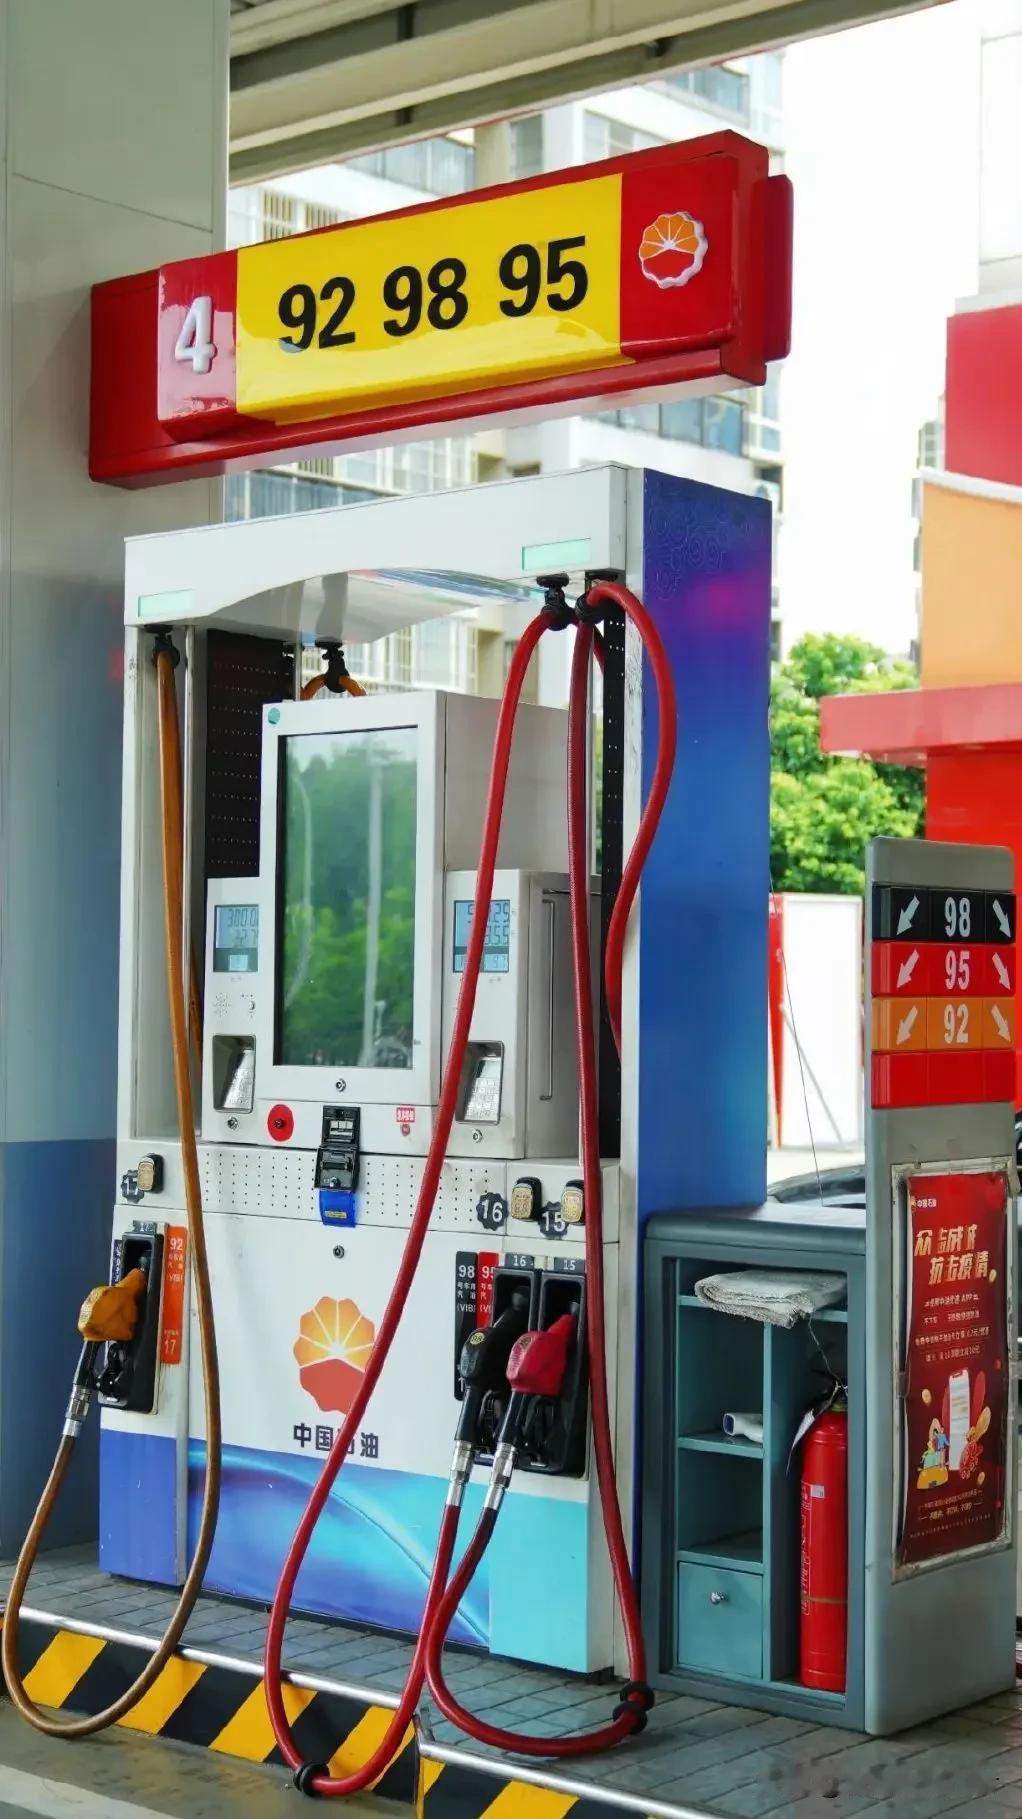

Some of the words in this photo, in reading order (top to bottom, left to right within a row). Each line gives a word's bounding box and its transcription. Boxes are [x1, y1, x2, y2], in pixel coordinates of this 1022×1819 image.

[278, 276, 355, 353] 92
[383, 257, 468, 338] 98
[499, 235, 588, 317] 95
[174, 296, 217, 374] 4
[944, 897, 971, 938] 98
[945, 950, 970, 990] 95
[944, 1004, 969, 1044] 92
[481, 1199, 503, 1223] 16
[542, 1211, 566, 1232] 15
[170, 1237, 183, 1250] 92
[458, 1265, 475, 1279] 98
[513, 1255, 526, 1267] 16
[563, 1260, 576, 1270] 15
[165, 1339, 177, 1354] 17
[293, 1422, 379, 1459] 中国油
